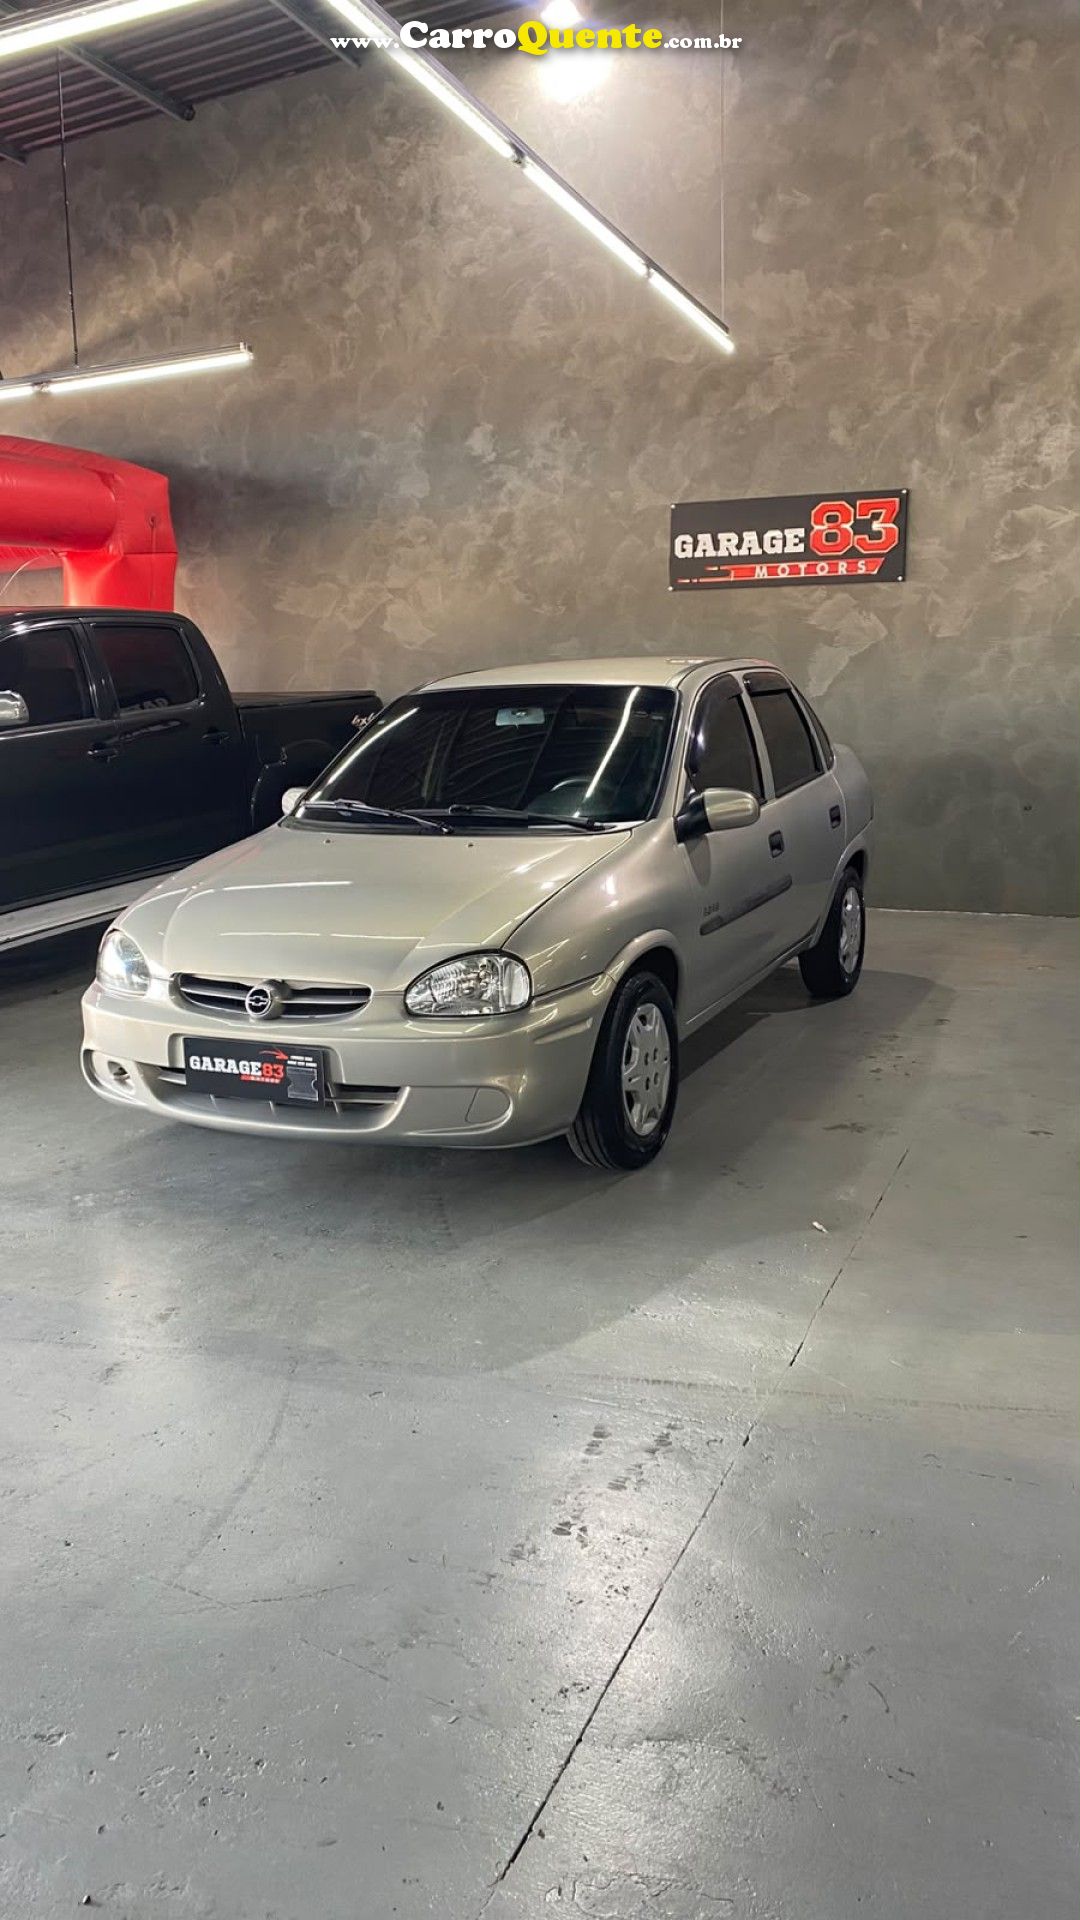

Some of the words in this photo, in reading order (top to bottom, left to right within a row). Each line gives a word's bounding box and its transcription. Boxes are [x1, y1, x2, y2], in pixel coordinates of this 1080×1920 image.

[674, 527, 805, 559] GARAGE
[809, 497, 900, 556] 83
[755, 560, 868, 579] MOTORS
